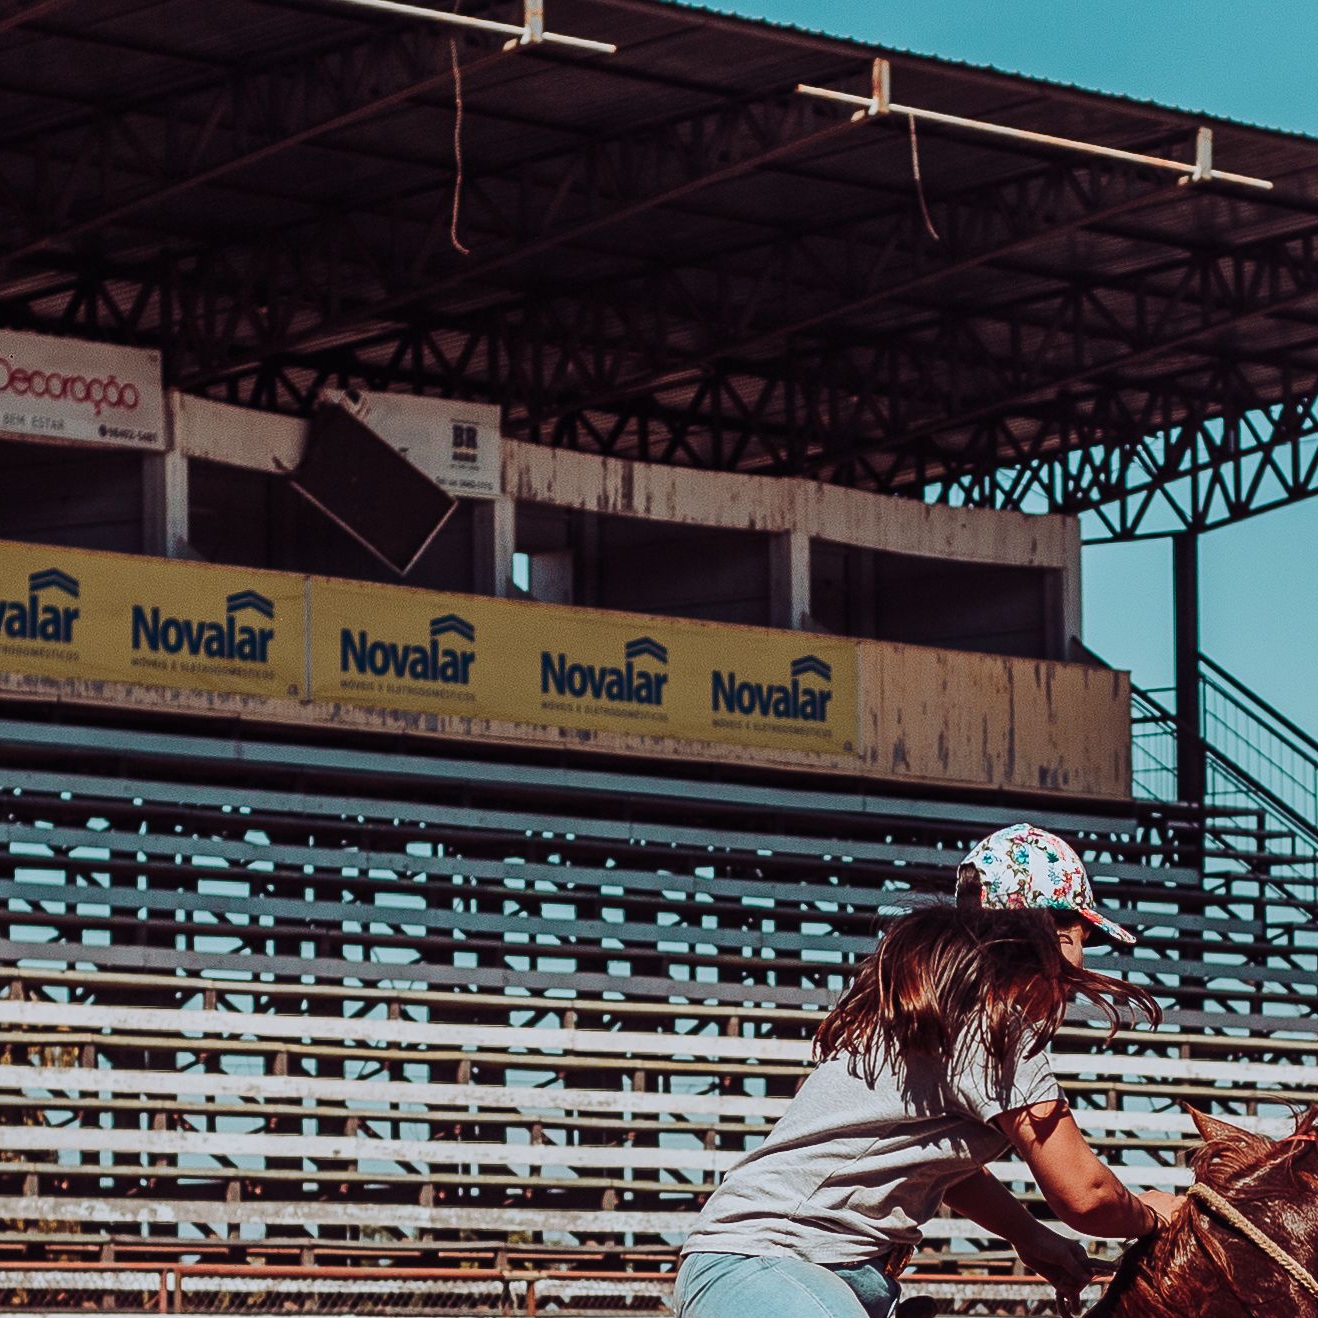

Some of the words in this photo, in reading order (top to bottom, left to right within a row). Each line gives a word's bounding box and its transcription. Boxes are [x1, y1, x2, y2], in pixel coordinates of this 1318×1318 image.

[132, 604, 275, 663] Novalar
[340, 628, 476, 685] Novalar
[540, 651, 668, 705] Novalar
[710, 670, 833, 723] Novalar
